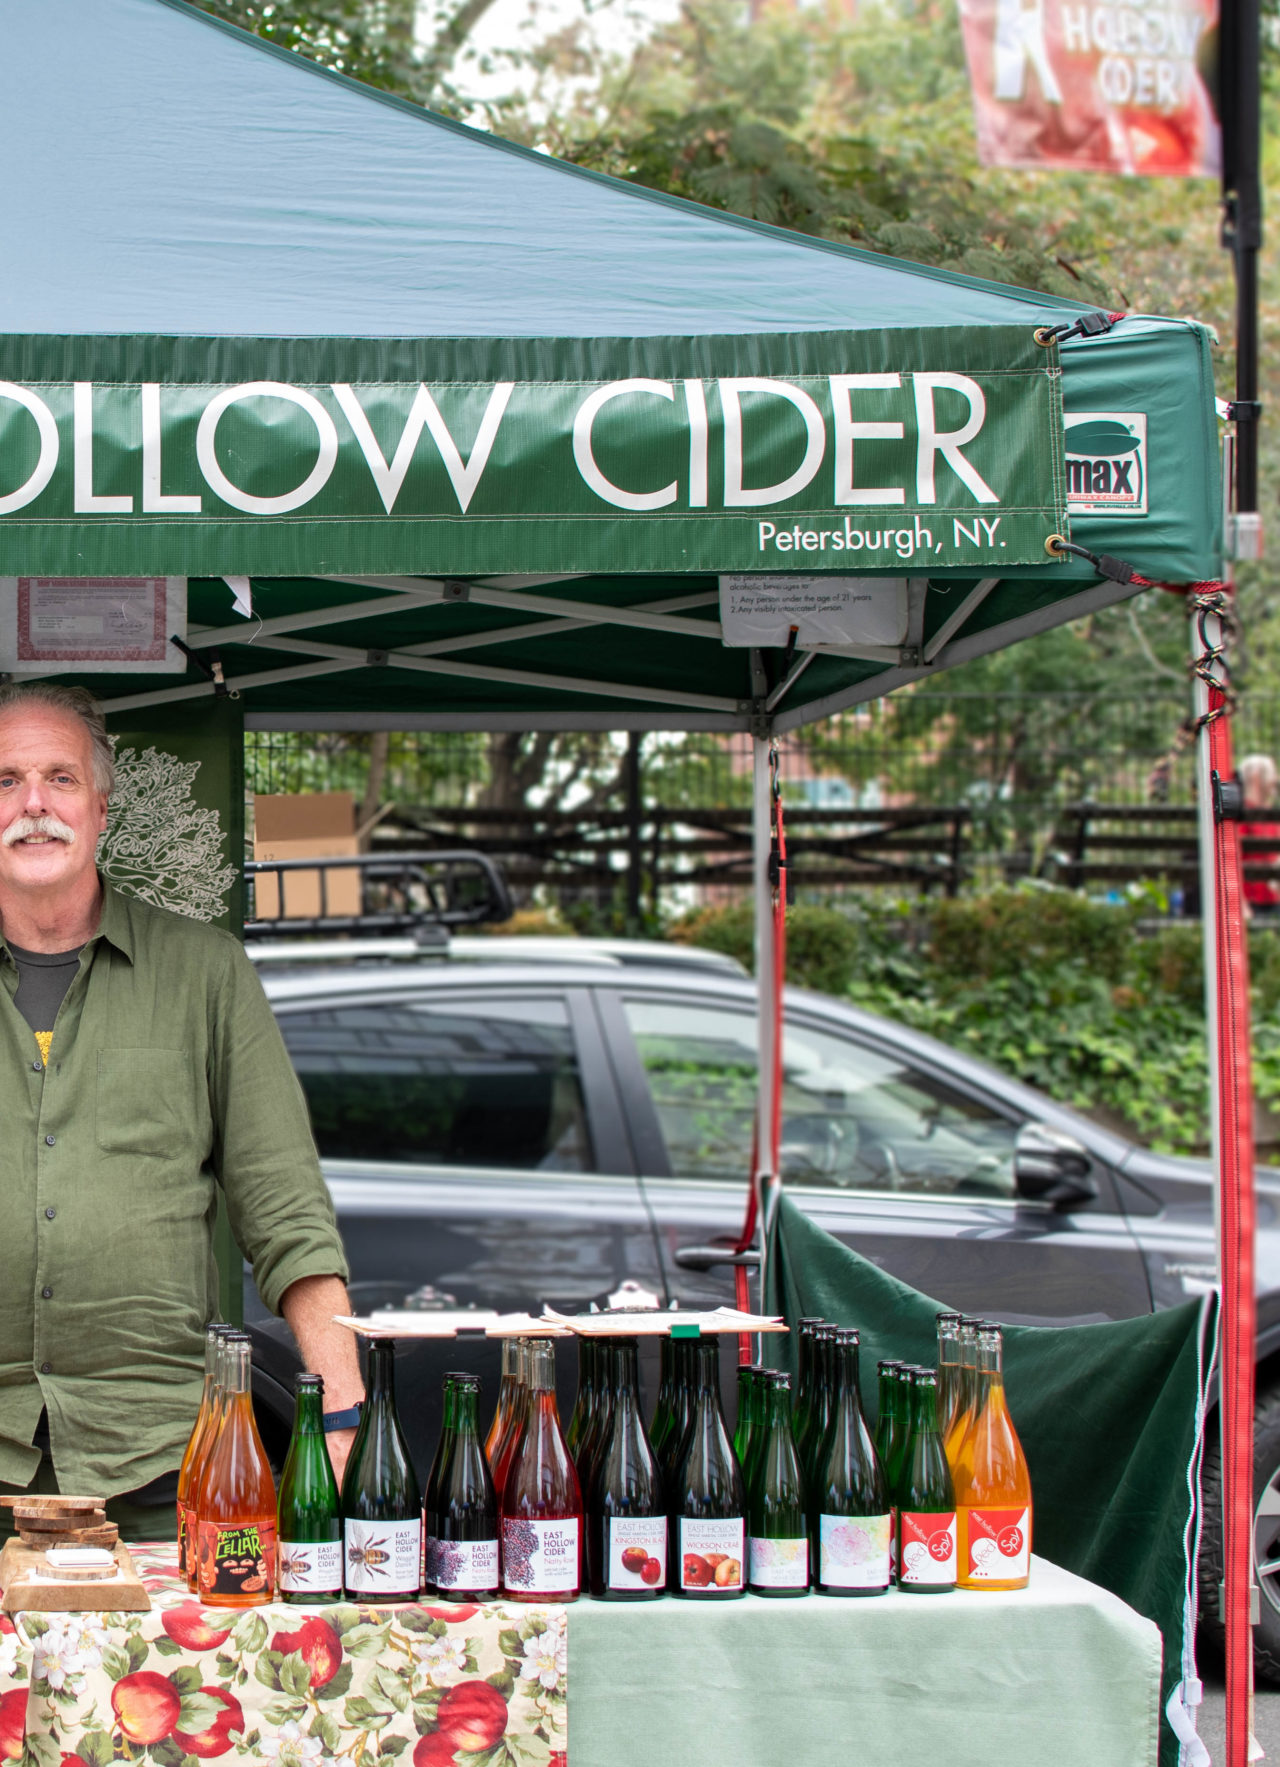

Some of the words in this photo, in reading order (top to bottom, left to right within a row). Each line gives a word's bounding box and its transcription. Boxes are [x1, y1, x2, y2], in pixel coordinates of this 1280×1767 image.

[572, 371, 1000, 511] CIDER
[758, 515, 943, 558] Petersburgh,
[953, 517, 1007, 548] NY.
[729, 582, 761, 591] alcoholic
[740, 596, 754, 604] Any
[756, 596, 780, 604] person
[782, 594, 802, 603] under
[804, 594, 815, 602] the
[816, 596, 831, 604] age
[841, 593, 850, 601] 21
[754, 605, 776, 614] visibly
[778, 604, 817, 613] intoxicated
[217, 1530, 240, 1540] FROM
[243, 1526, 258, 1535] THE
[543, 1531, 563, 1539] EAST
[543, 1538, 575, 1548] HOLLOW
[615, 1537, 651, 1545] KINGSTON
[687, 1541, 721, 1549] WICKSON
[931, 1533, 951, 1557] Spy
[1000, 1528, 1020, 1552] Spy
[472, 1544, 489, 1552] EAST
[543, 1547, 566, 1556] CIDER
[472, 1559, 491, 1567] CIDER
